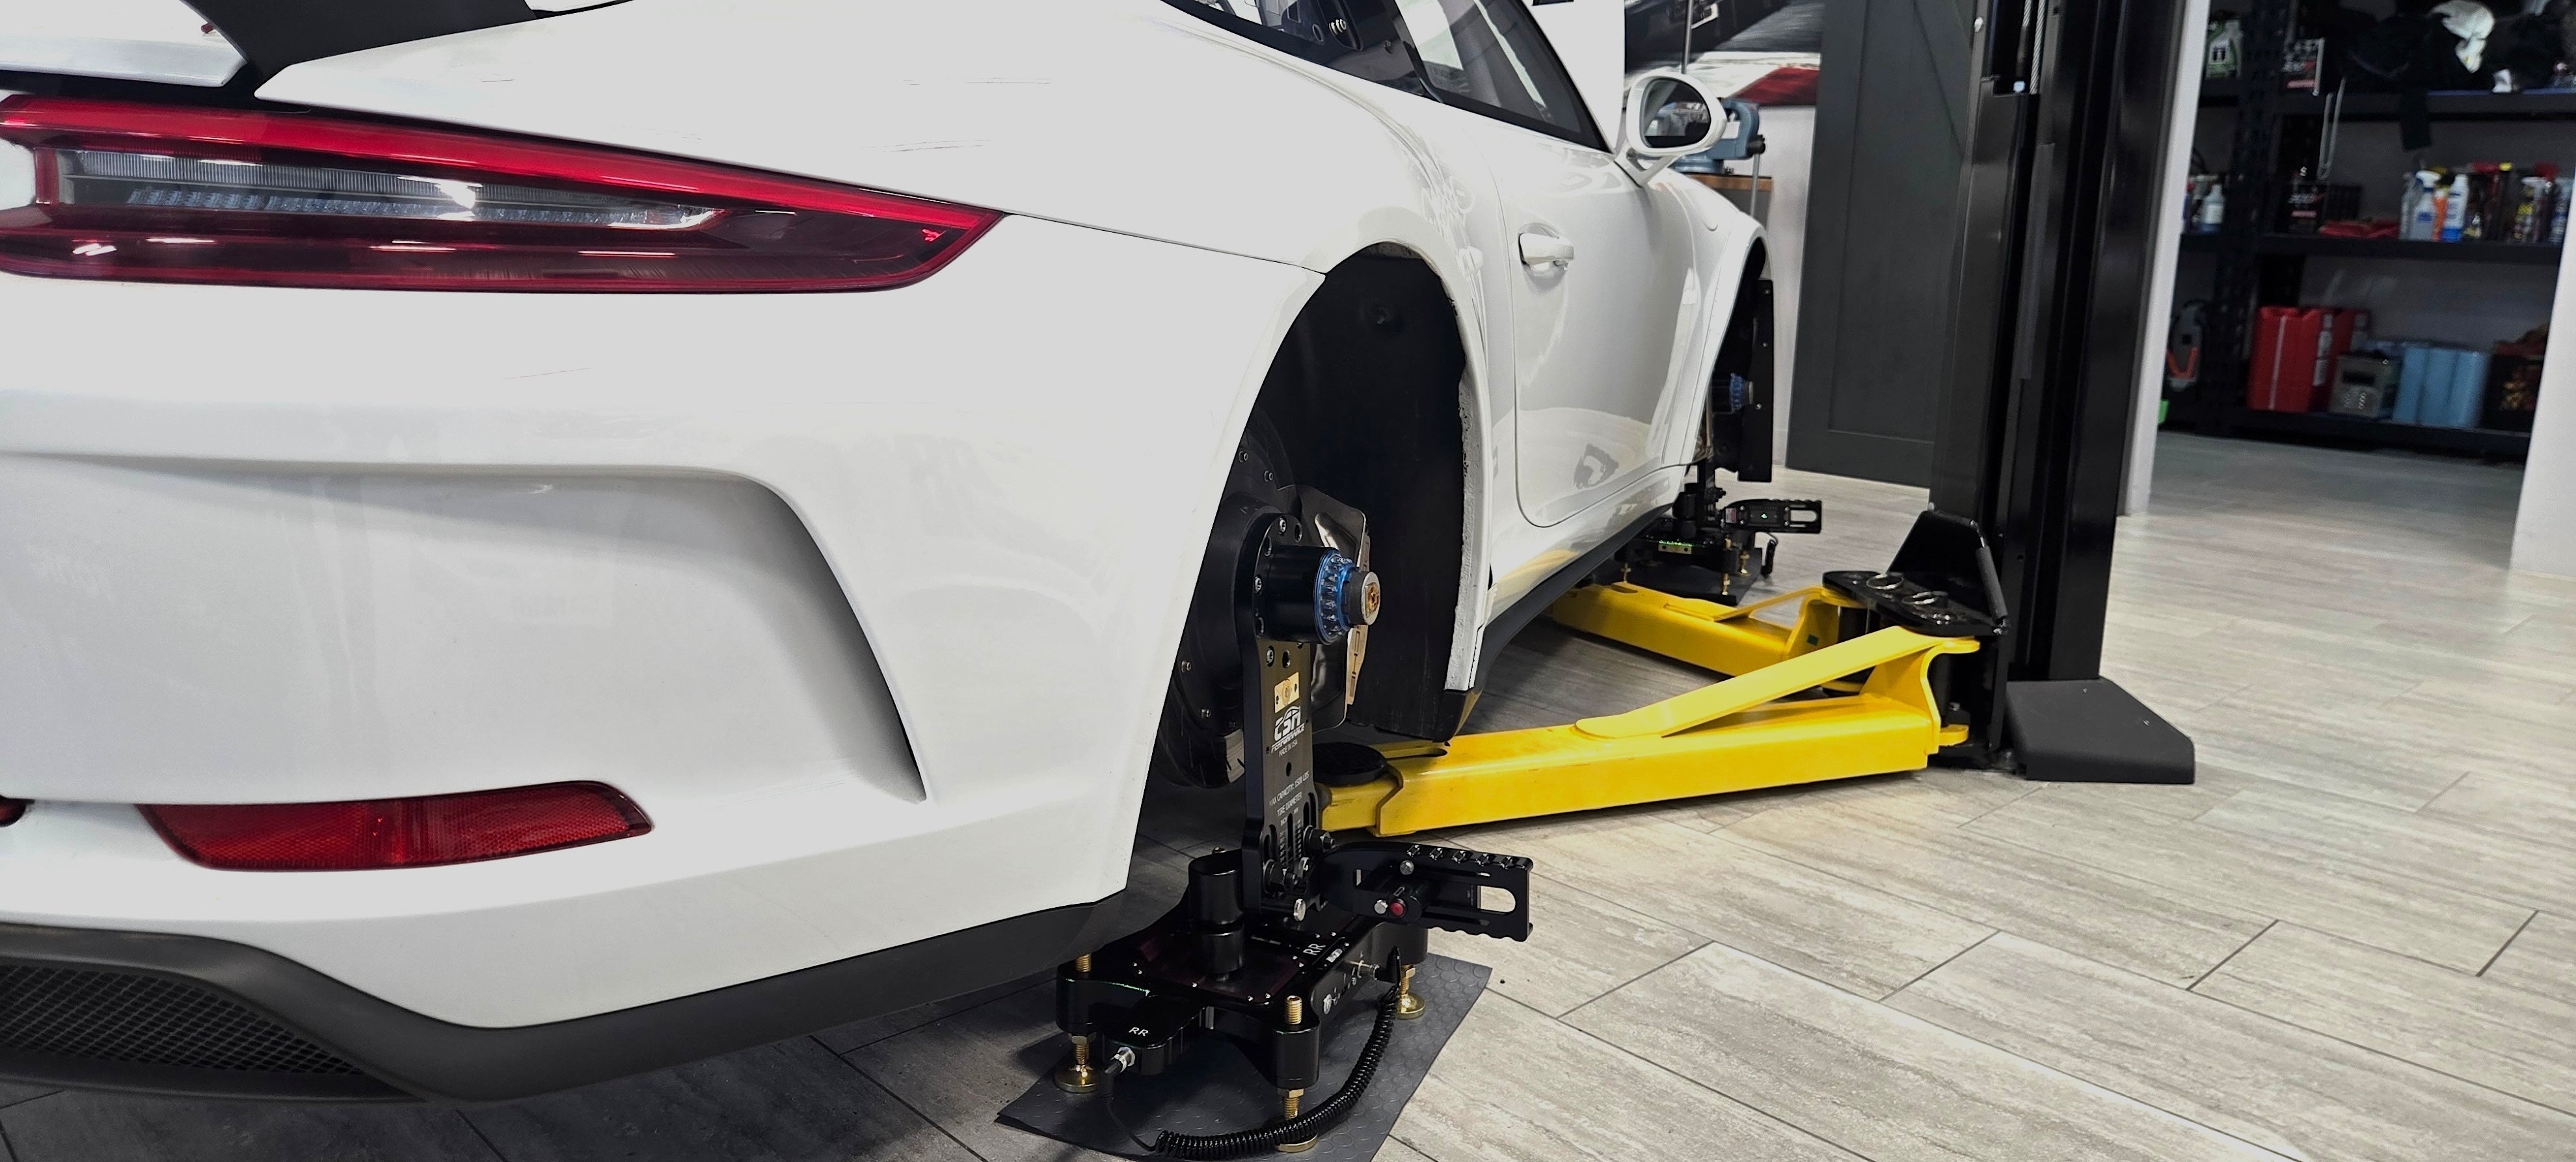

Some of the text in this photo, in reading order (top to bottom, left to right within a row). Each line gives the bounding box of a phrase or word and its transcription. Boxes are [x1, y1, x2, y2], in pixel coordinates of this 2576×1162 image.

[1277, 791, 1302, 817] TIRE DIAMETER
[1302, 944, 1326, 956] RR
[1128, 1027, 1149, 1037] RR
